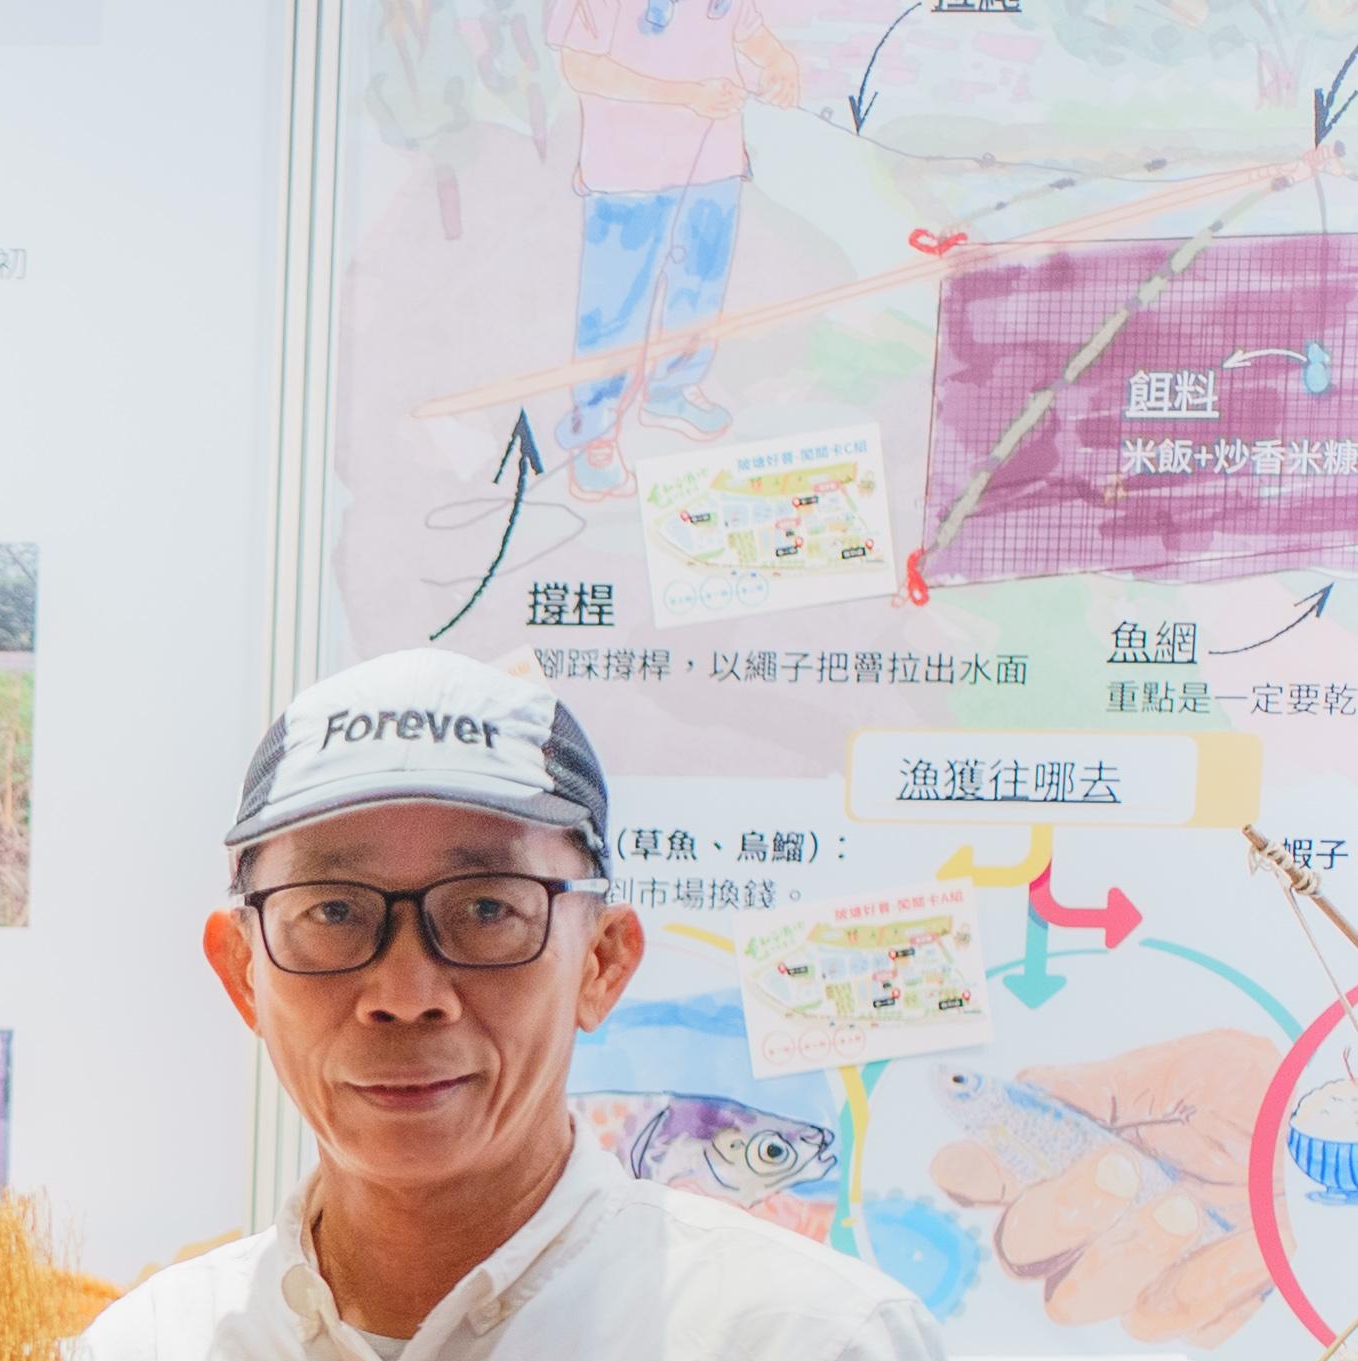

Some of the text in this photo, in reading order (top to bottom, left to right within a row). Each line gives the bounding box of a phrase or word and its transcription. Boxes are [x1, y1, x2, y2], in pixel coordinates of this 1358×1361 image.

[1124, 369, 1220, 418] 餌料
[1107, 620, 1198, 665] 魚網
[321, 709, 500, 750] Forever
[896, 758, 1122, 804] 漁獲往哪去
